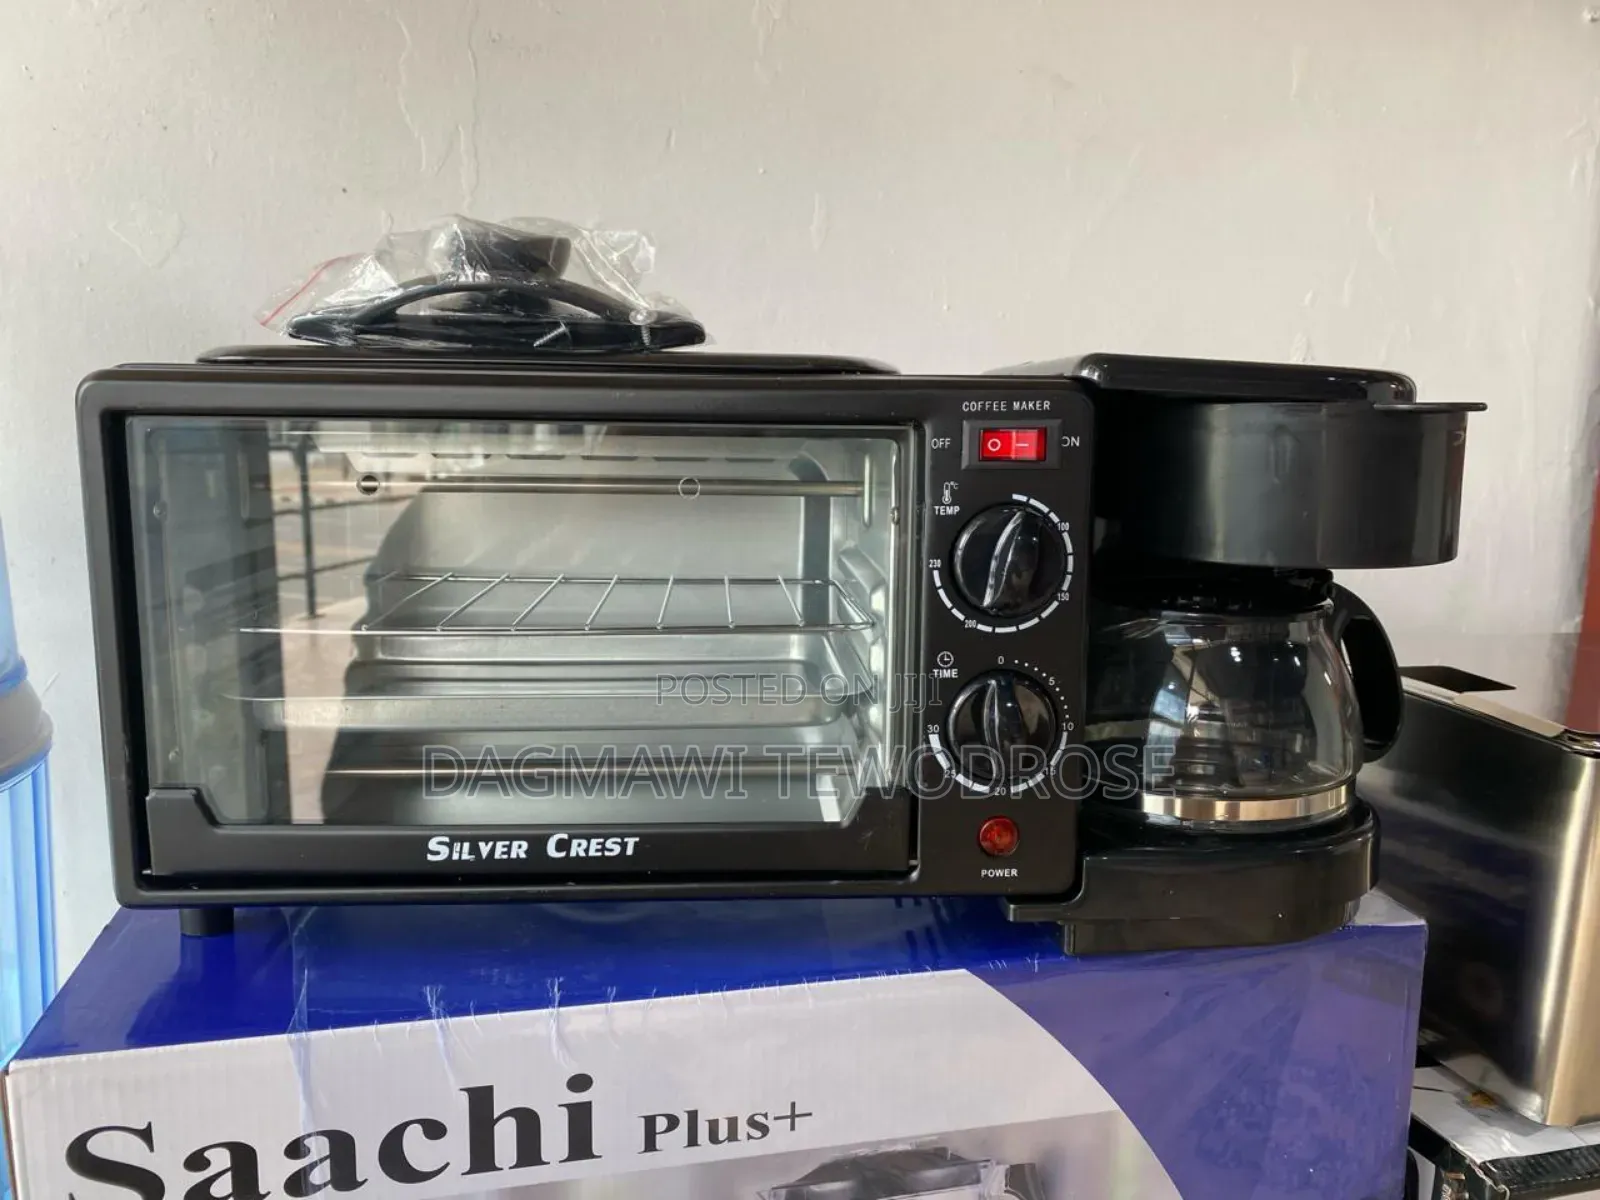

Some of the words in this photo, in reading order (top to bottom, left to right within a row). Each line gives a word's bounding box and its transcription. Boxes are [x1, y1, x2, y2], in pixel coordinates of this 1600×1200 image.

[962, 401, 1007, 412] COFFEE
[1013, 401, 1051, 411] MAKER
[931, 438, 951, 449] OFF
[1061, 436, 1080, 448] ON
[934, 505, 960, 516] TEMP
[1057, 522, 1070, 531] 100
[929, 559, 942, 568] 230
[1057, 592, 1070, 601] 150
[964, 619, 977, 629] 200
[997, 655, 1005, 665] 0
[933, 669, 959, 679] TIME
[1048, 677, 1055, 686] 5
[927, 724, 940, 733] 30
[1063, 722, 1075, 732] 10
[994, 787, 1007, 797] 20
[981, 868, 1018, 878] POWER
[65, 1073, 602, 1200] Saachi
[638, 1101, 813, 1154] Plus+
